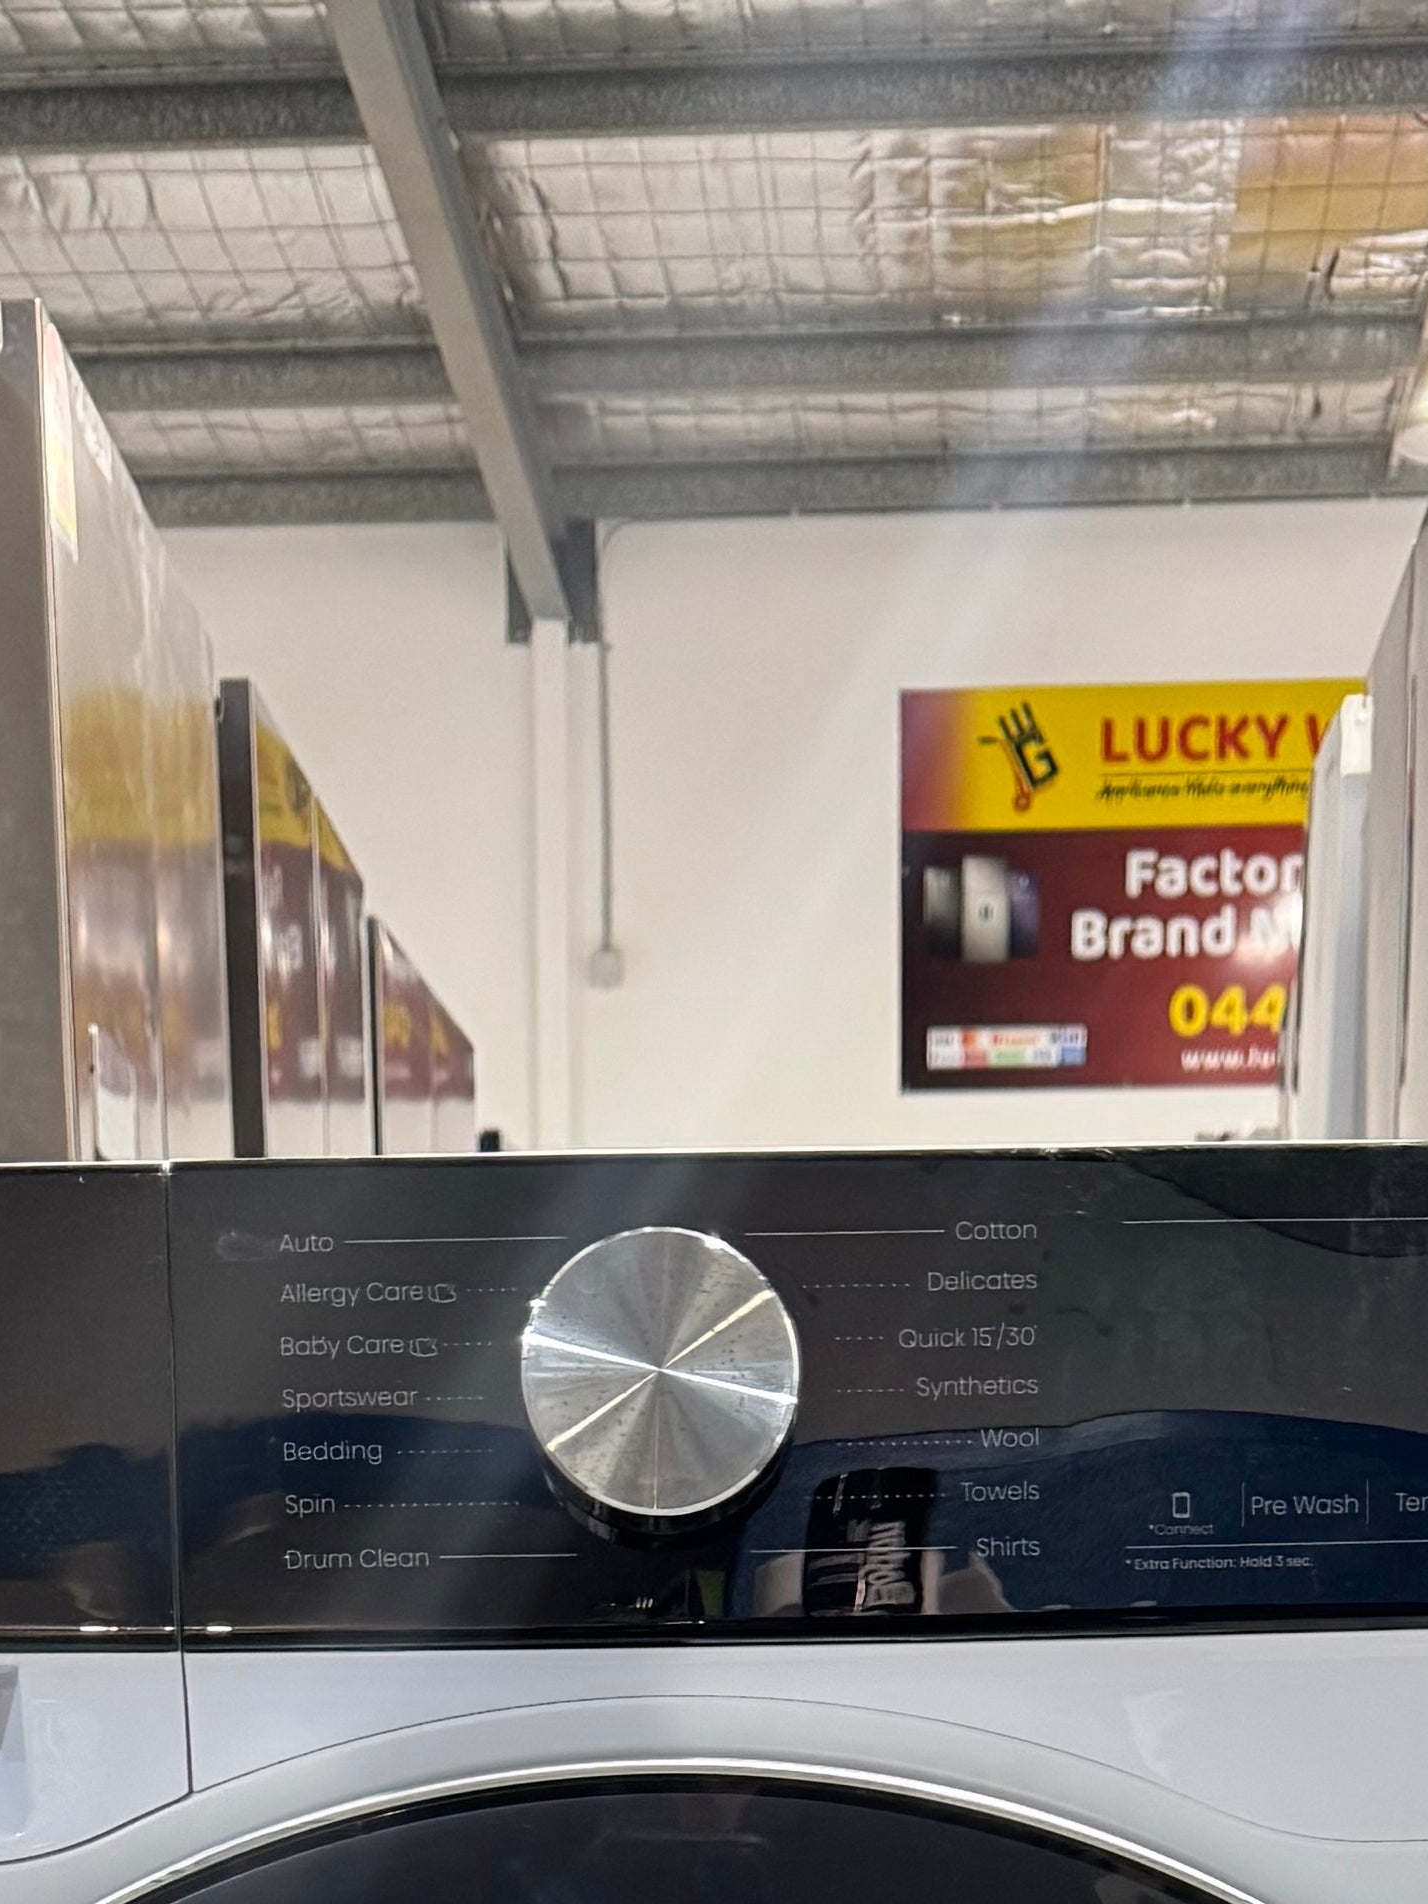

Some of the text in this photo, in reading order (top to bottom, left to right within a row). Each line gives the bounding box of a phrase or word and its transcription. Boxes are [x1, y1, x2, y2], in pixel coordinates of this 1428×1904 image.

[1101, 714, 1290, 763] LUCKY
[1071, 903, 1237, 961] Brand
[955, 1221, 1038, 1240] Cotton
[279, 1233, 334, 1253] Auto
[927, 1271, 1038, 1292] Delicates
[280, 1283, 424, 1307] Allergy Care
[280, 1335, 403, 1361] Baby Care
[898, 1328, 966, 1349] Quick
[916, 1375, 1039, 1401] Synthetics
[282, 1388, 418, 1411] Sportswear
[981, 1428, 1040, 1449] Wool
[283, 1441, 383, 1465] Bedding
[960, 1481, 1040, 1502] Towels
[285, 1494, 336, 1519] Spin
[1251, 1494, 1359, 1516] Pre Wash
[286, 1546, 430, 1569] Drum Clean
[976, 1536, 1041, 1558] Shirts
[1134, 1558, 1171, 1570] Extra
[1173, 1557, 1237, 1569] Function:
[1240, 1556, 1273, 1568] Hold
[1275, 1556, 1284, 1567] 3
[1286, 1556, 1314, 1567] sec.
